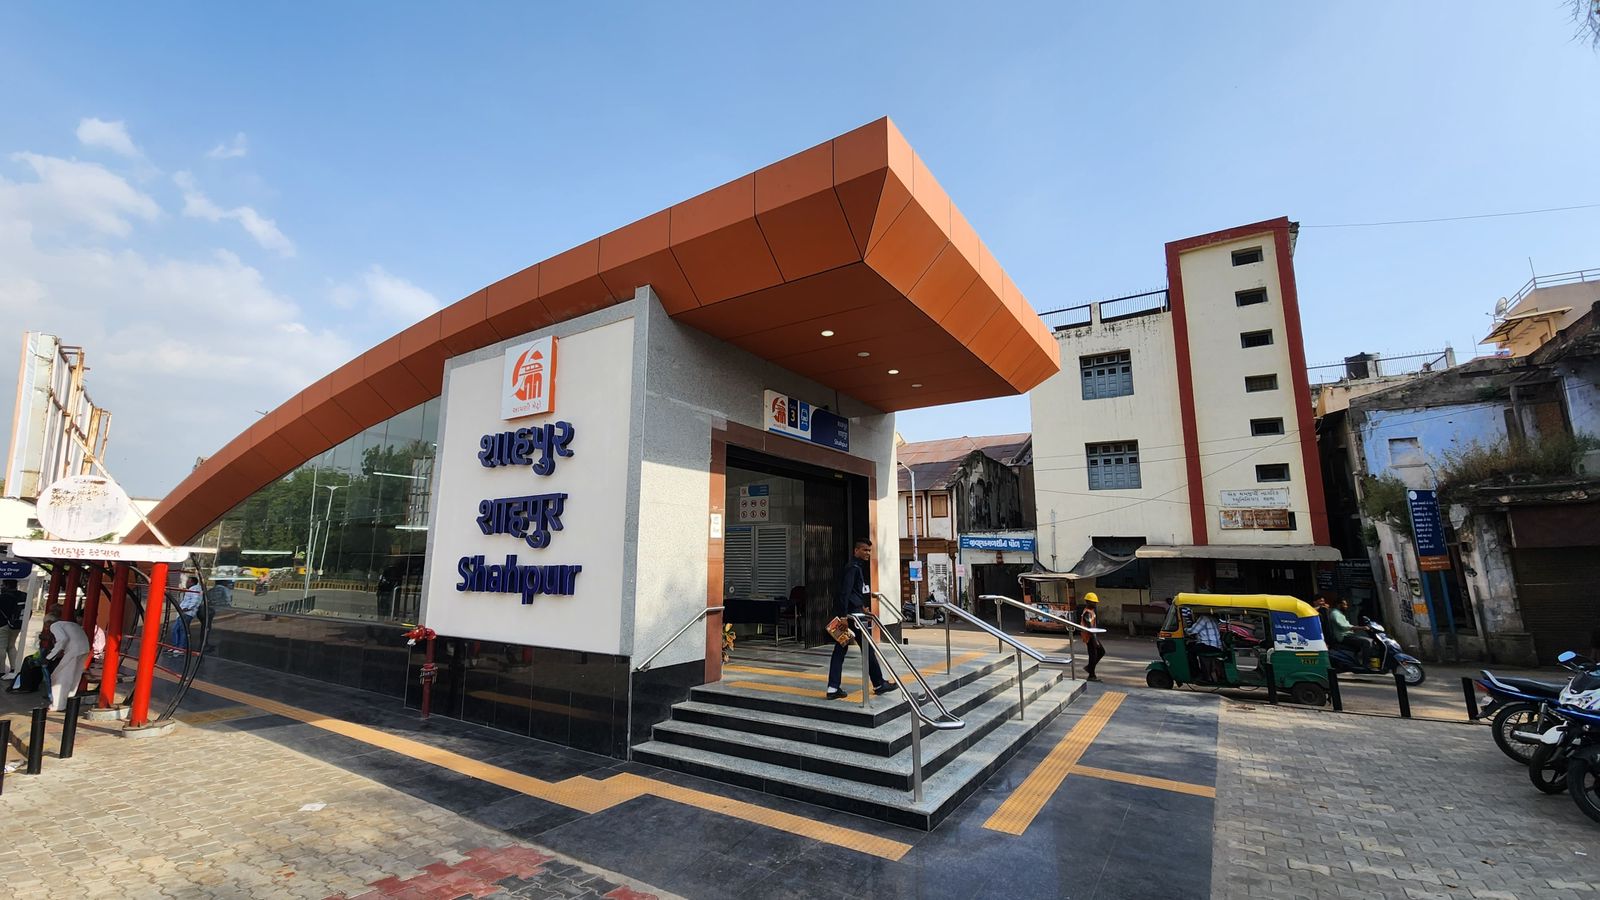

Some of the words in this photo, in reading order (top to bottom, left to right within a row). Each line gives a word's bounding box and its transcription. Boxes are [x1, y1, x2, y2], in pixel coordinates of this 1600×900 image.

[790, 409, 796, 422] 3
[478, 420, 575, 476] શાહપુર
[476, 492, 568, 549] शाहपुर
[50, 546, 85, 558] શાહપુર
[89, 548, 121, 558] દરવાજા
[456, 554, 583, 604] Shahpur
